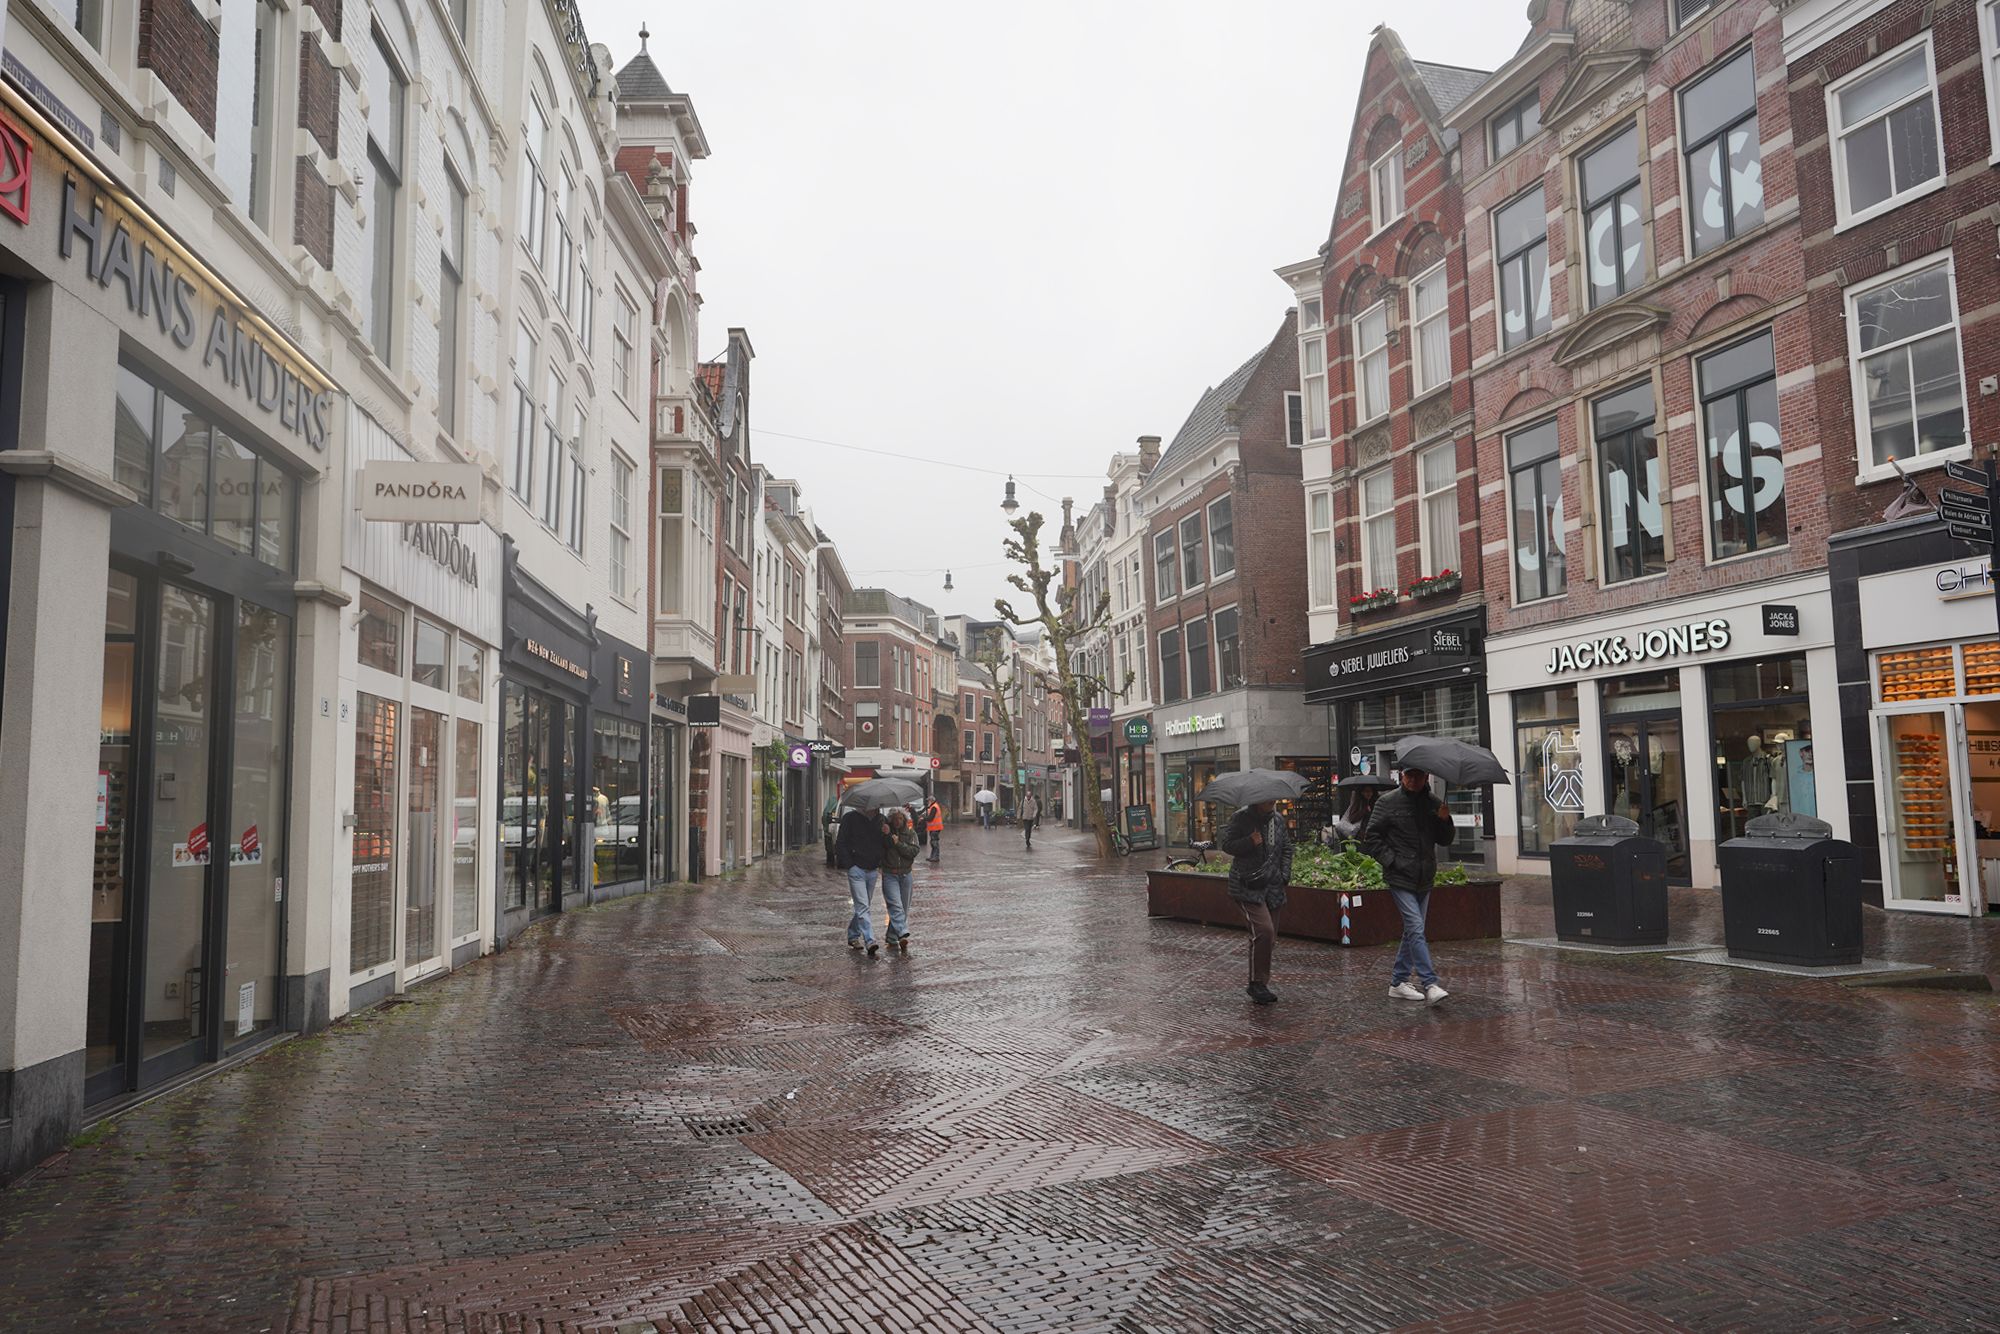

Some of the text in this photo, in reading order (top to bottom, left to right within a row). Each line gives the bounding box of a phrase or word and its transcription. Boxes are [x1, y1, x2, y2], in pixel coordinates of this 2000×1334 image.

[61, 173, 333, 453] HANS ANDERS
[1769, 612, 1794, 620] JACK&
[1769, 620, 1795, 628] JONES
[1433, 635, 1462, 646] SIEBEL
[538, 644, 549, 660] NEW
[549, 650, 569, 670] ZEALAND
[568, 661, 588, 680] AUCKLAND
[1340, 655, 1365, 675] SIEBEL
[1366, 646, 1409, 672] JUWELIERS
[324, 700, 328, 712] 3
